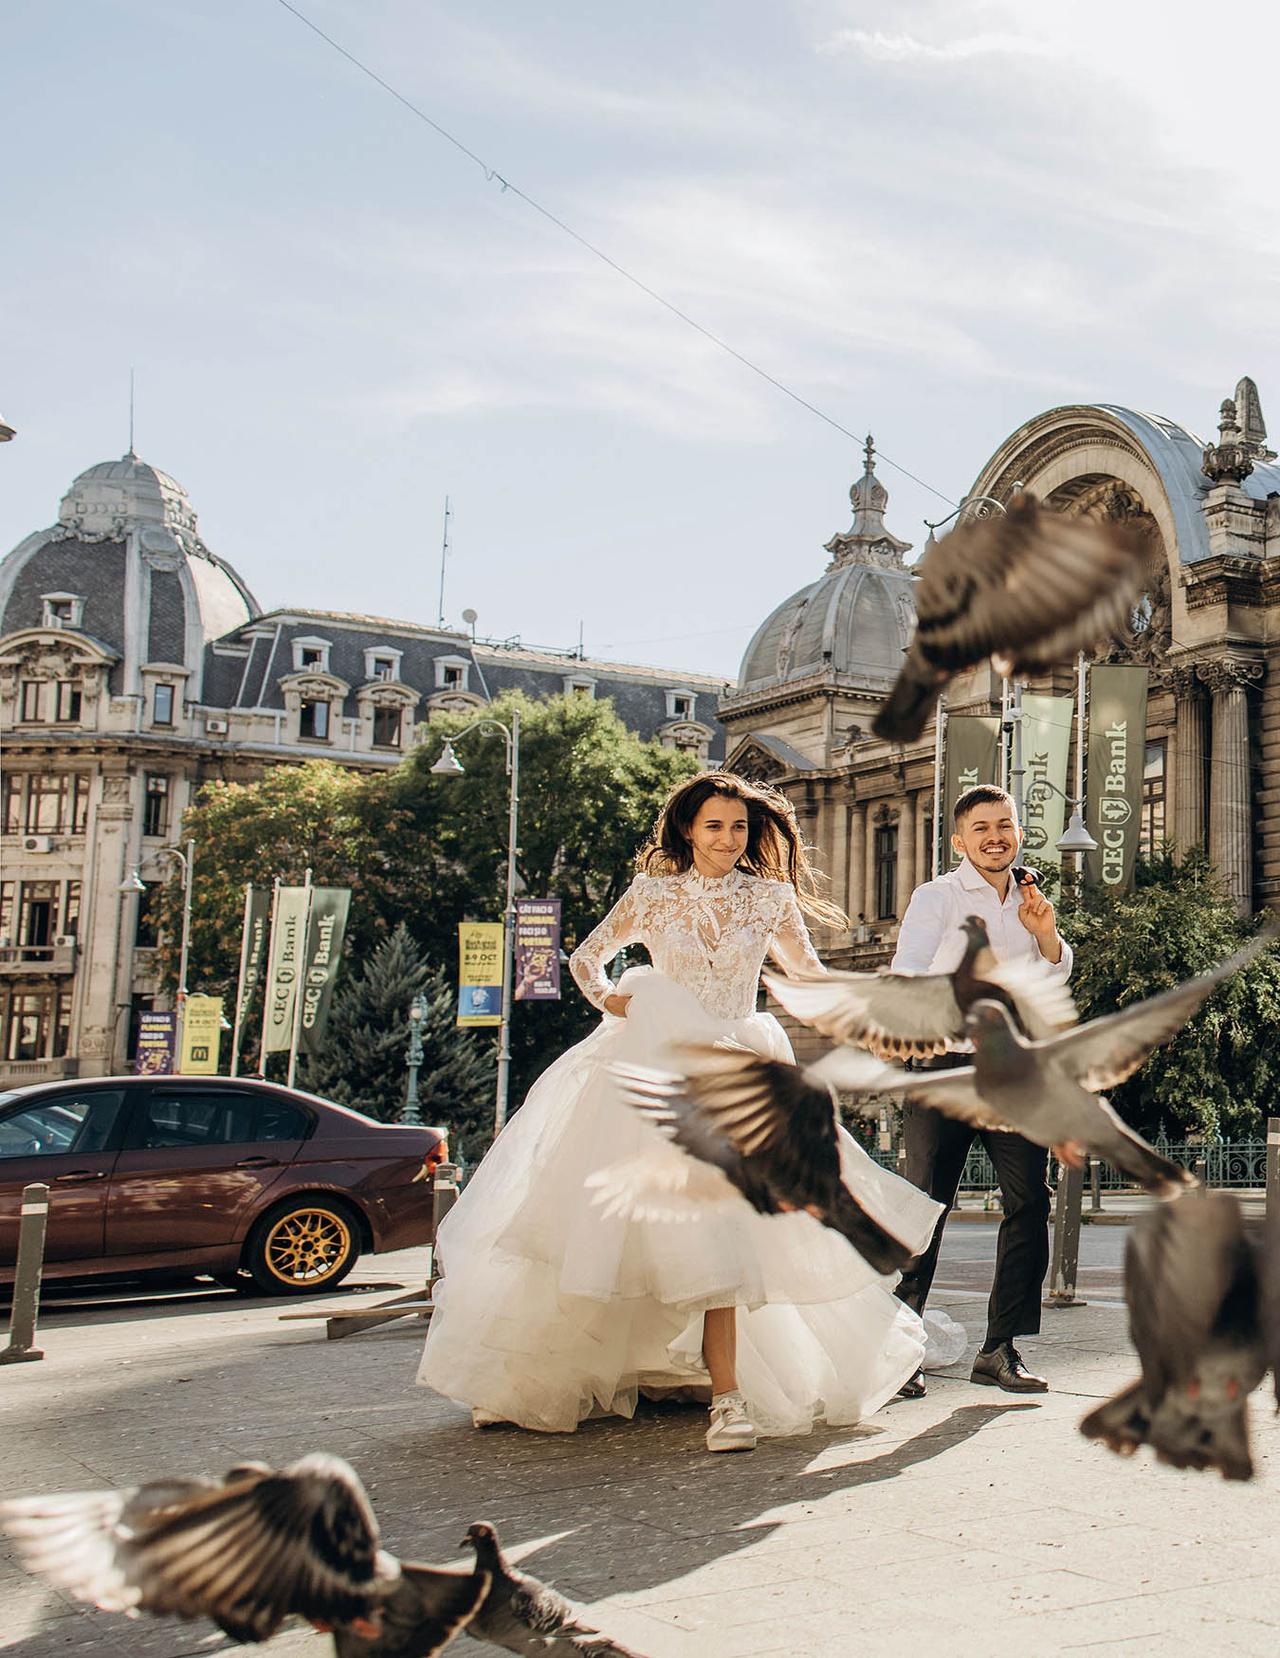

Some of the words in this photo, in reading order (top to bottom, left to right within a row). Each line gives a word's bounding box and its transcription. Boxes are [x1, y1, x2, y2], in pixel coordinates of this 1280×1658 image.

[1029, 751, 1049, 820] Bank
[1105, 720, 1127, 793] Bank
[1102, 829, 1125, 885] CEC
[273, 987, 289, 1025] CEC
[282, 915, 296, 962] Bank
[303, 987, 321, 1029] CEC
[313, 914, 336, 964] Bank
